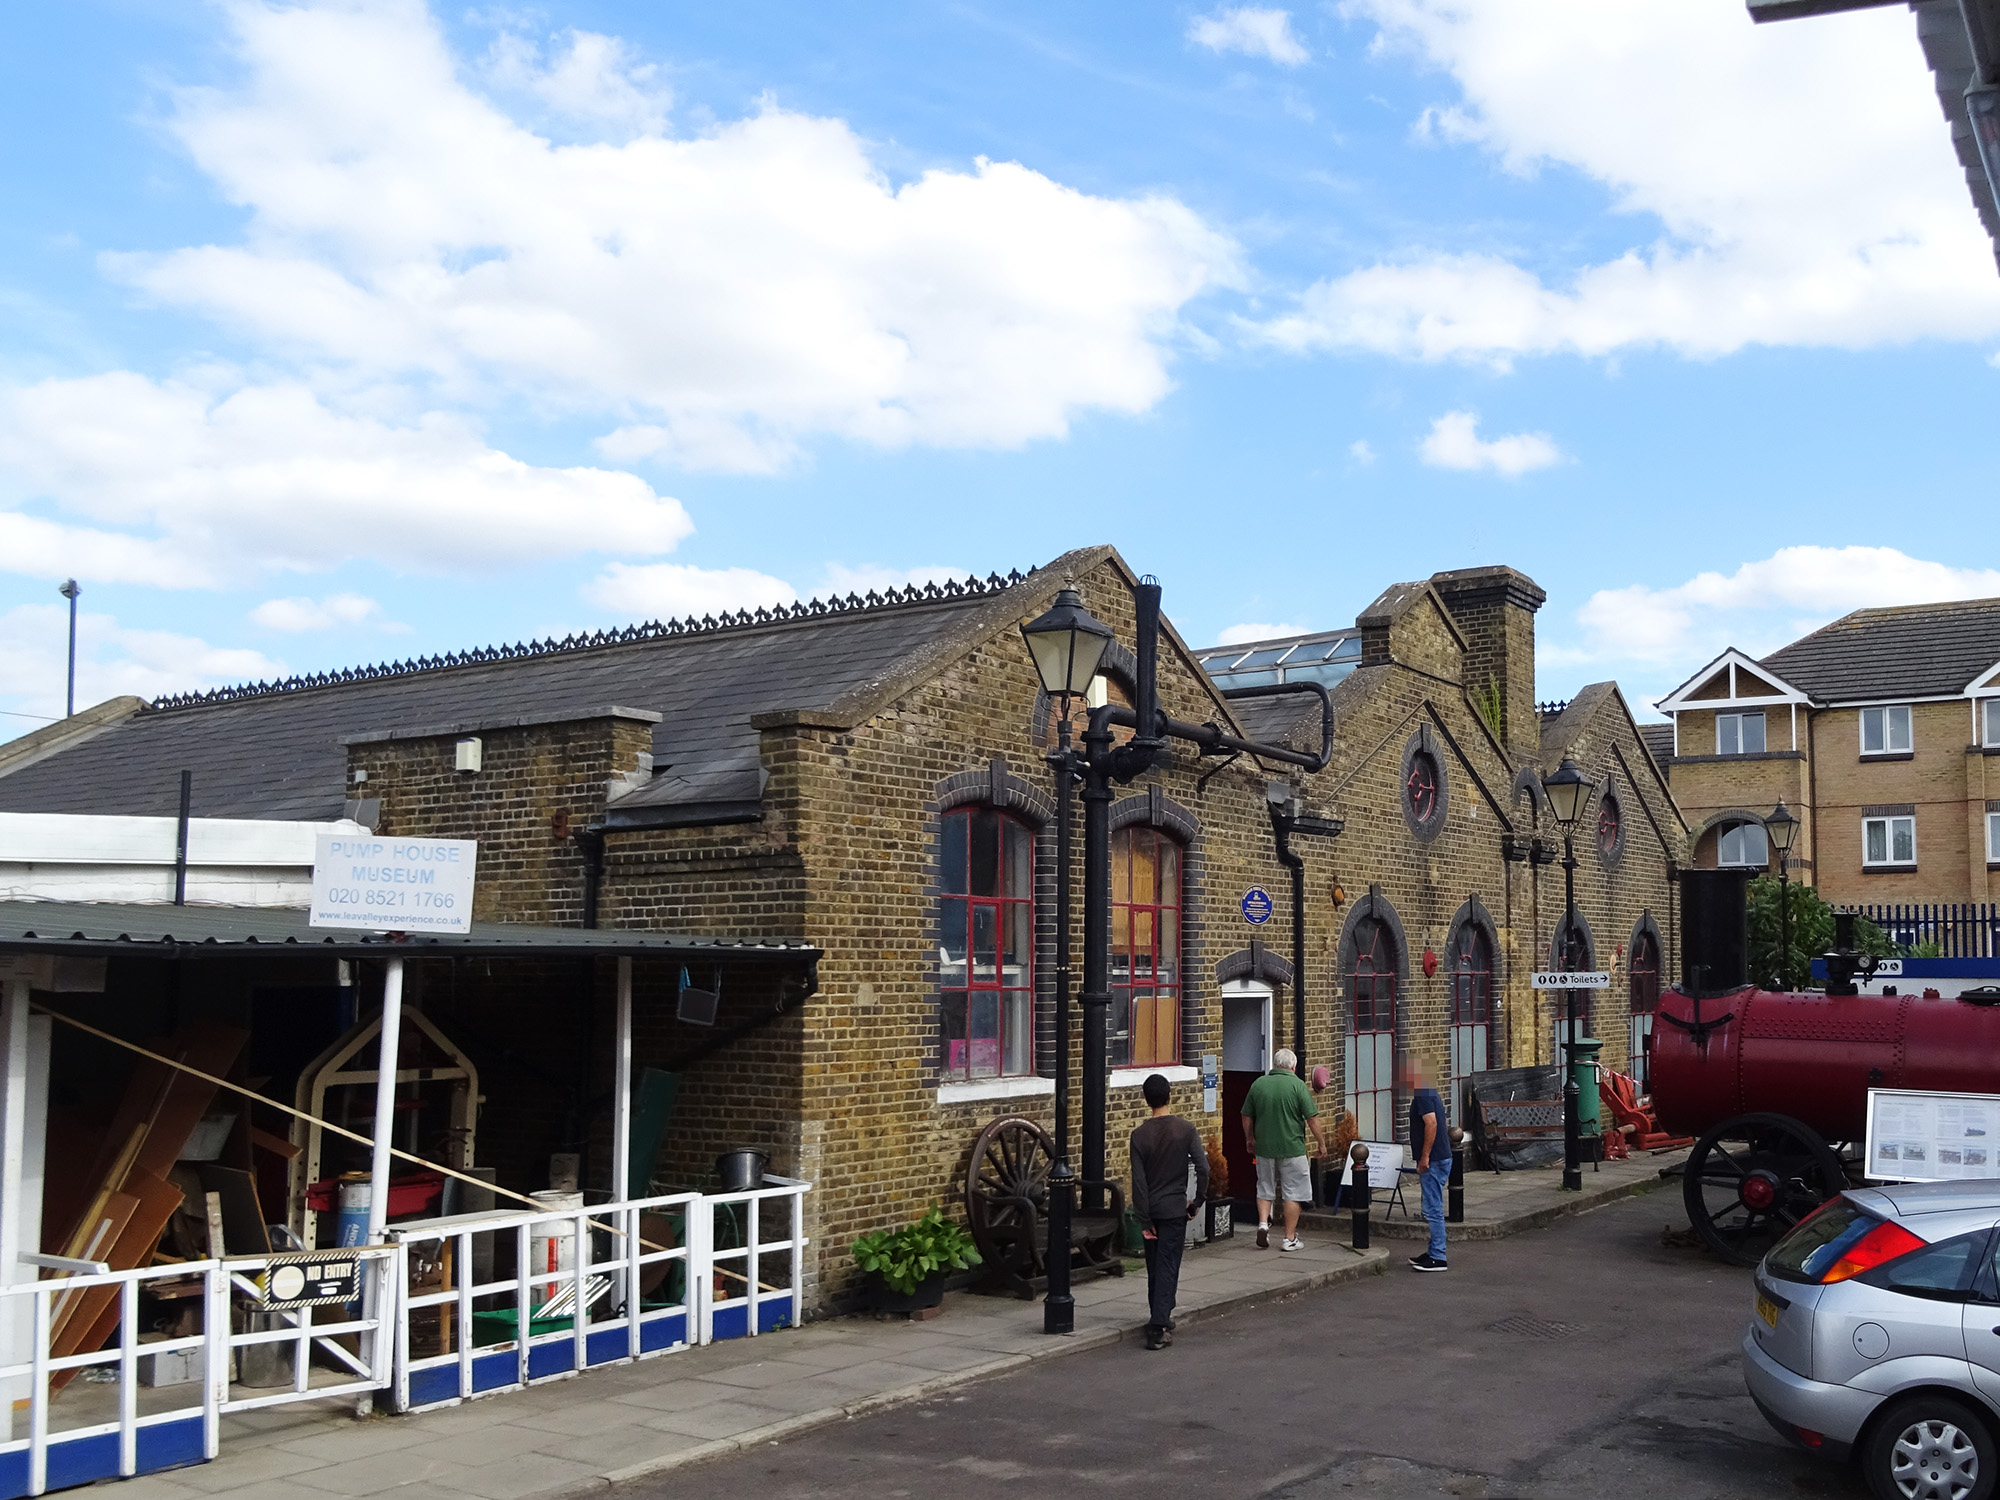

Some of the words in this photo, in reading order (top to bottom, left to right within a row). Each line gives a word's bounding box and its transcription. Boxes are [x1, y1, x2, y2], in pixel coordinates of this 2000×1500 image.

[330, 842, 384, 859] PUMP
[393, 845, 460, 863] HOUSE
[352, 866, 435, 884] MUSEUM
[328, 887, 360, 904] 020
[365, 889, 405, 906] 8521
[414, 892, 455, 909] 1766
[318, 911, 463, 926] www.leavalleyexperience.co.uk
[1569, 975, 1599, 984] Toilets
[306, 1265, 322, 1281] NO
[324, 1262, 353, 1279] ENTRY
